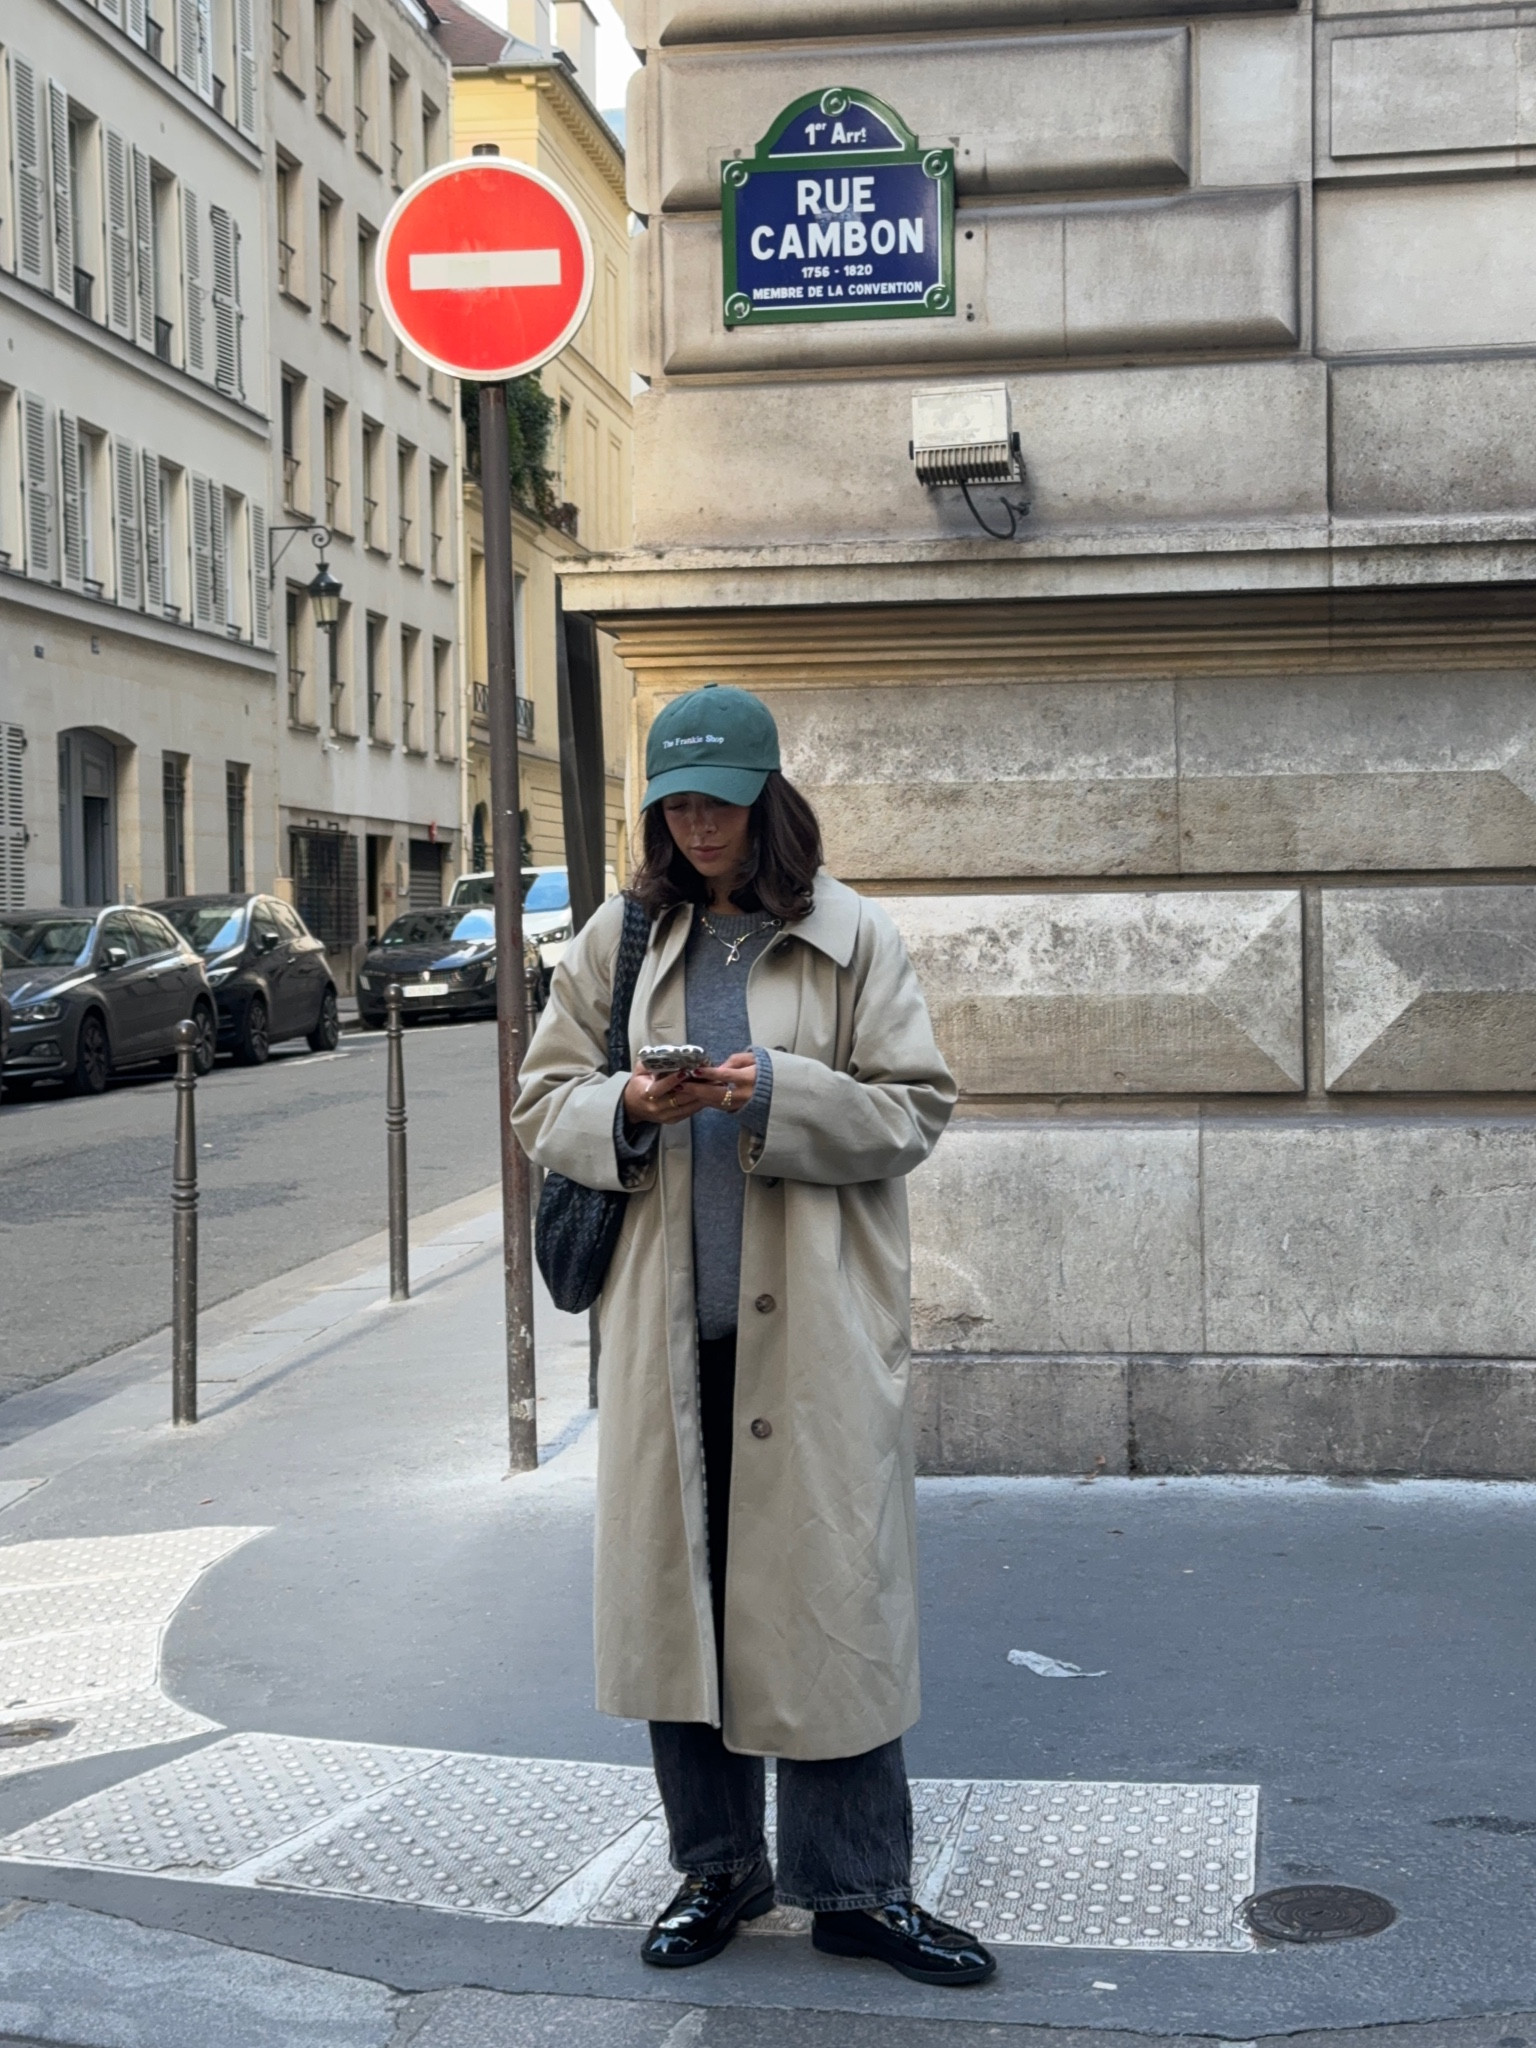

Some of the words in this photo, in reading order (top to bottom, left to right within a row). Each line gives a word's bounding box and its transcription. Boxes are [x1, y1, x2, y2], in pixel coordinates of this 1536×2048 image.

[805, 122, 827, 146] 1er
[797, 176, 875, 216] RUE
[751, 217, 924, 260] CAMBON
[801, 266, 830, 278] 1756
[843, 264, 873, 276] 1820
[752, 286, 804, 300] MEMBRE
[808, 285, 824, 297] DE
[827, 284, 843, 296] LA
[848, 281, 923, 295] CONVENTION
[662, 740, 674, 749] The
[705, 734, 725, 744] Shop
